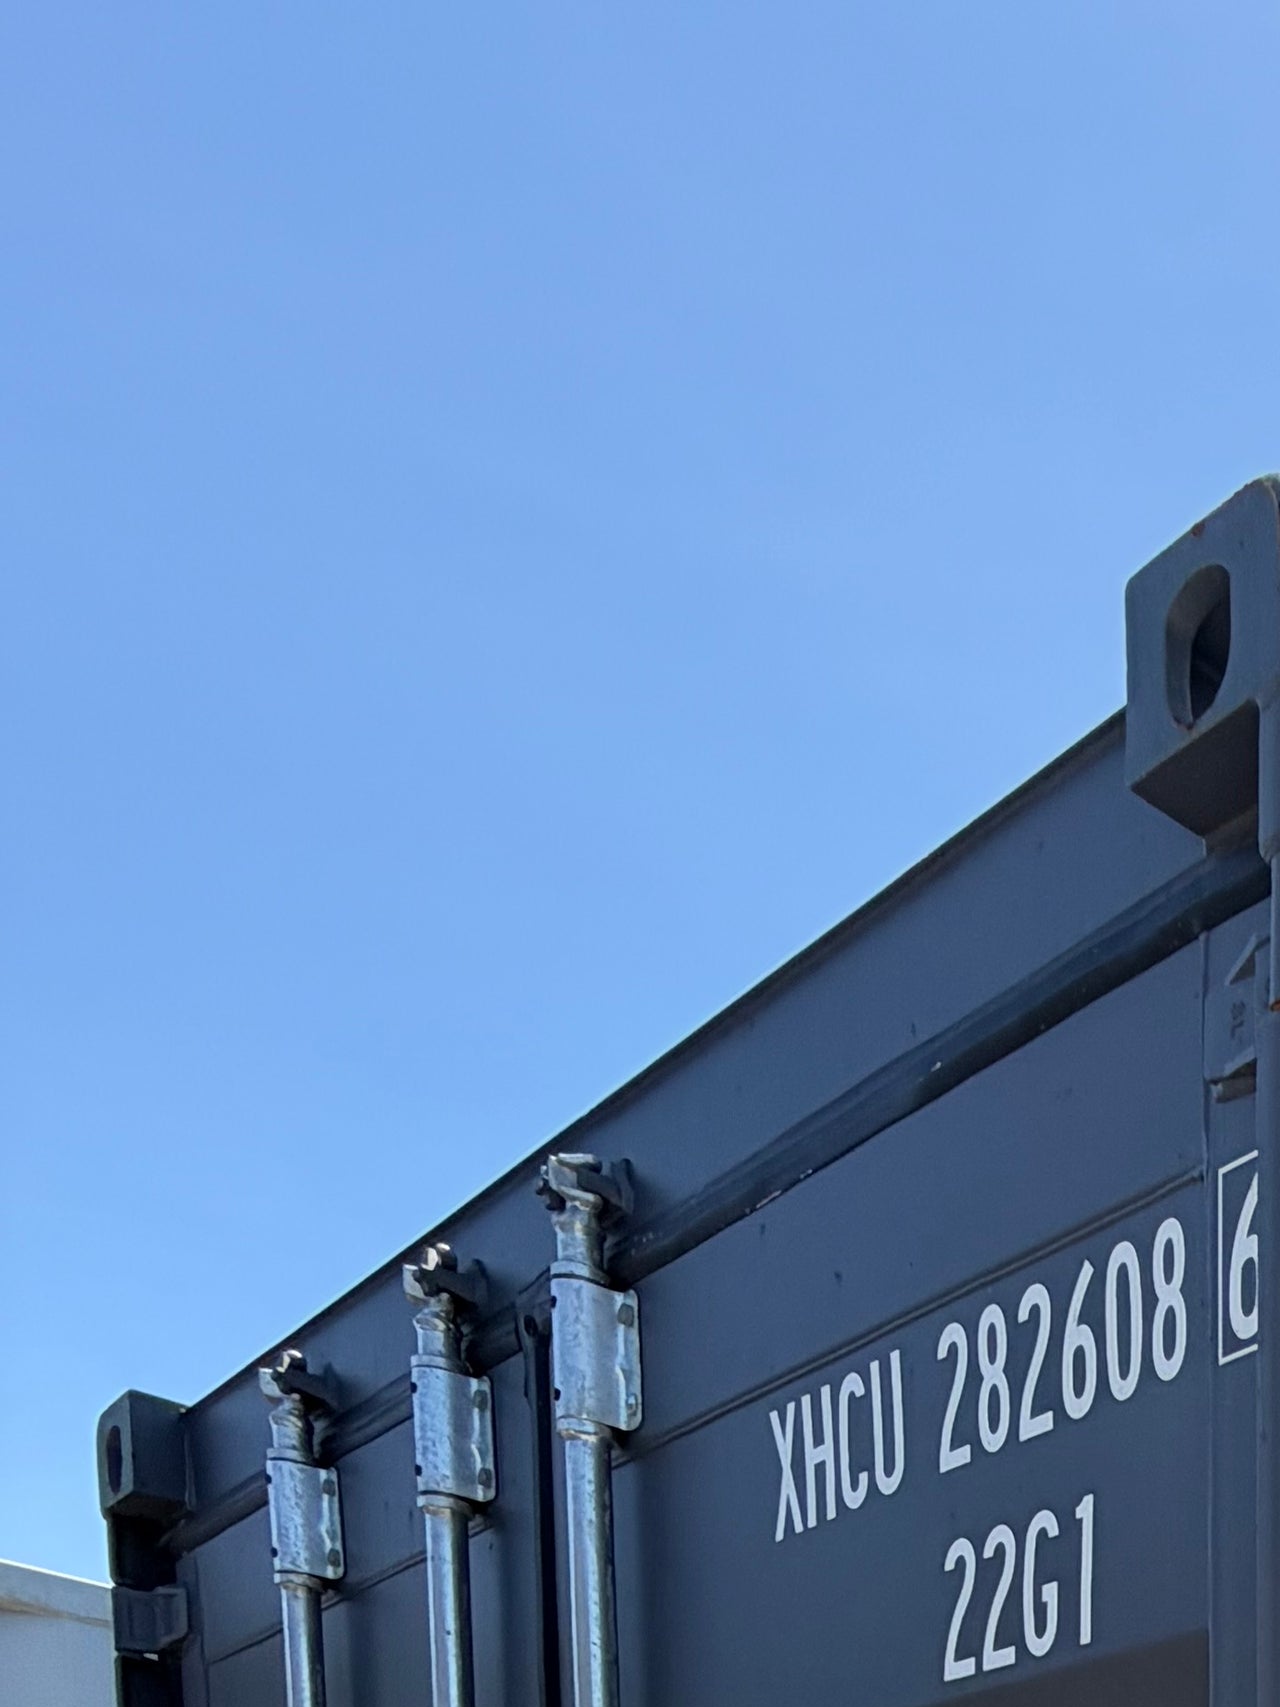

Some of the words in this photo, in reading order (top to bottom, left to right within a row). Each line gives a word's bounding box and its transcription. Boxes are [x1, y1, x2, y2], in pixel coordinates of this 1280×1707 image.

[770, 1350, 904, 1542] XHCU
[937, 1218, 1186, 1473] 282608
[1229, 1173, 1258, 1339] 6
[944, 1494, 1093, 1681] 22G1
